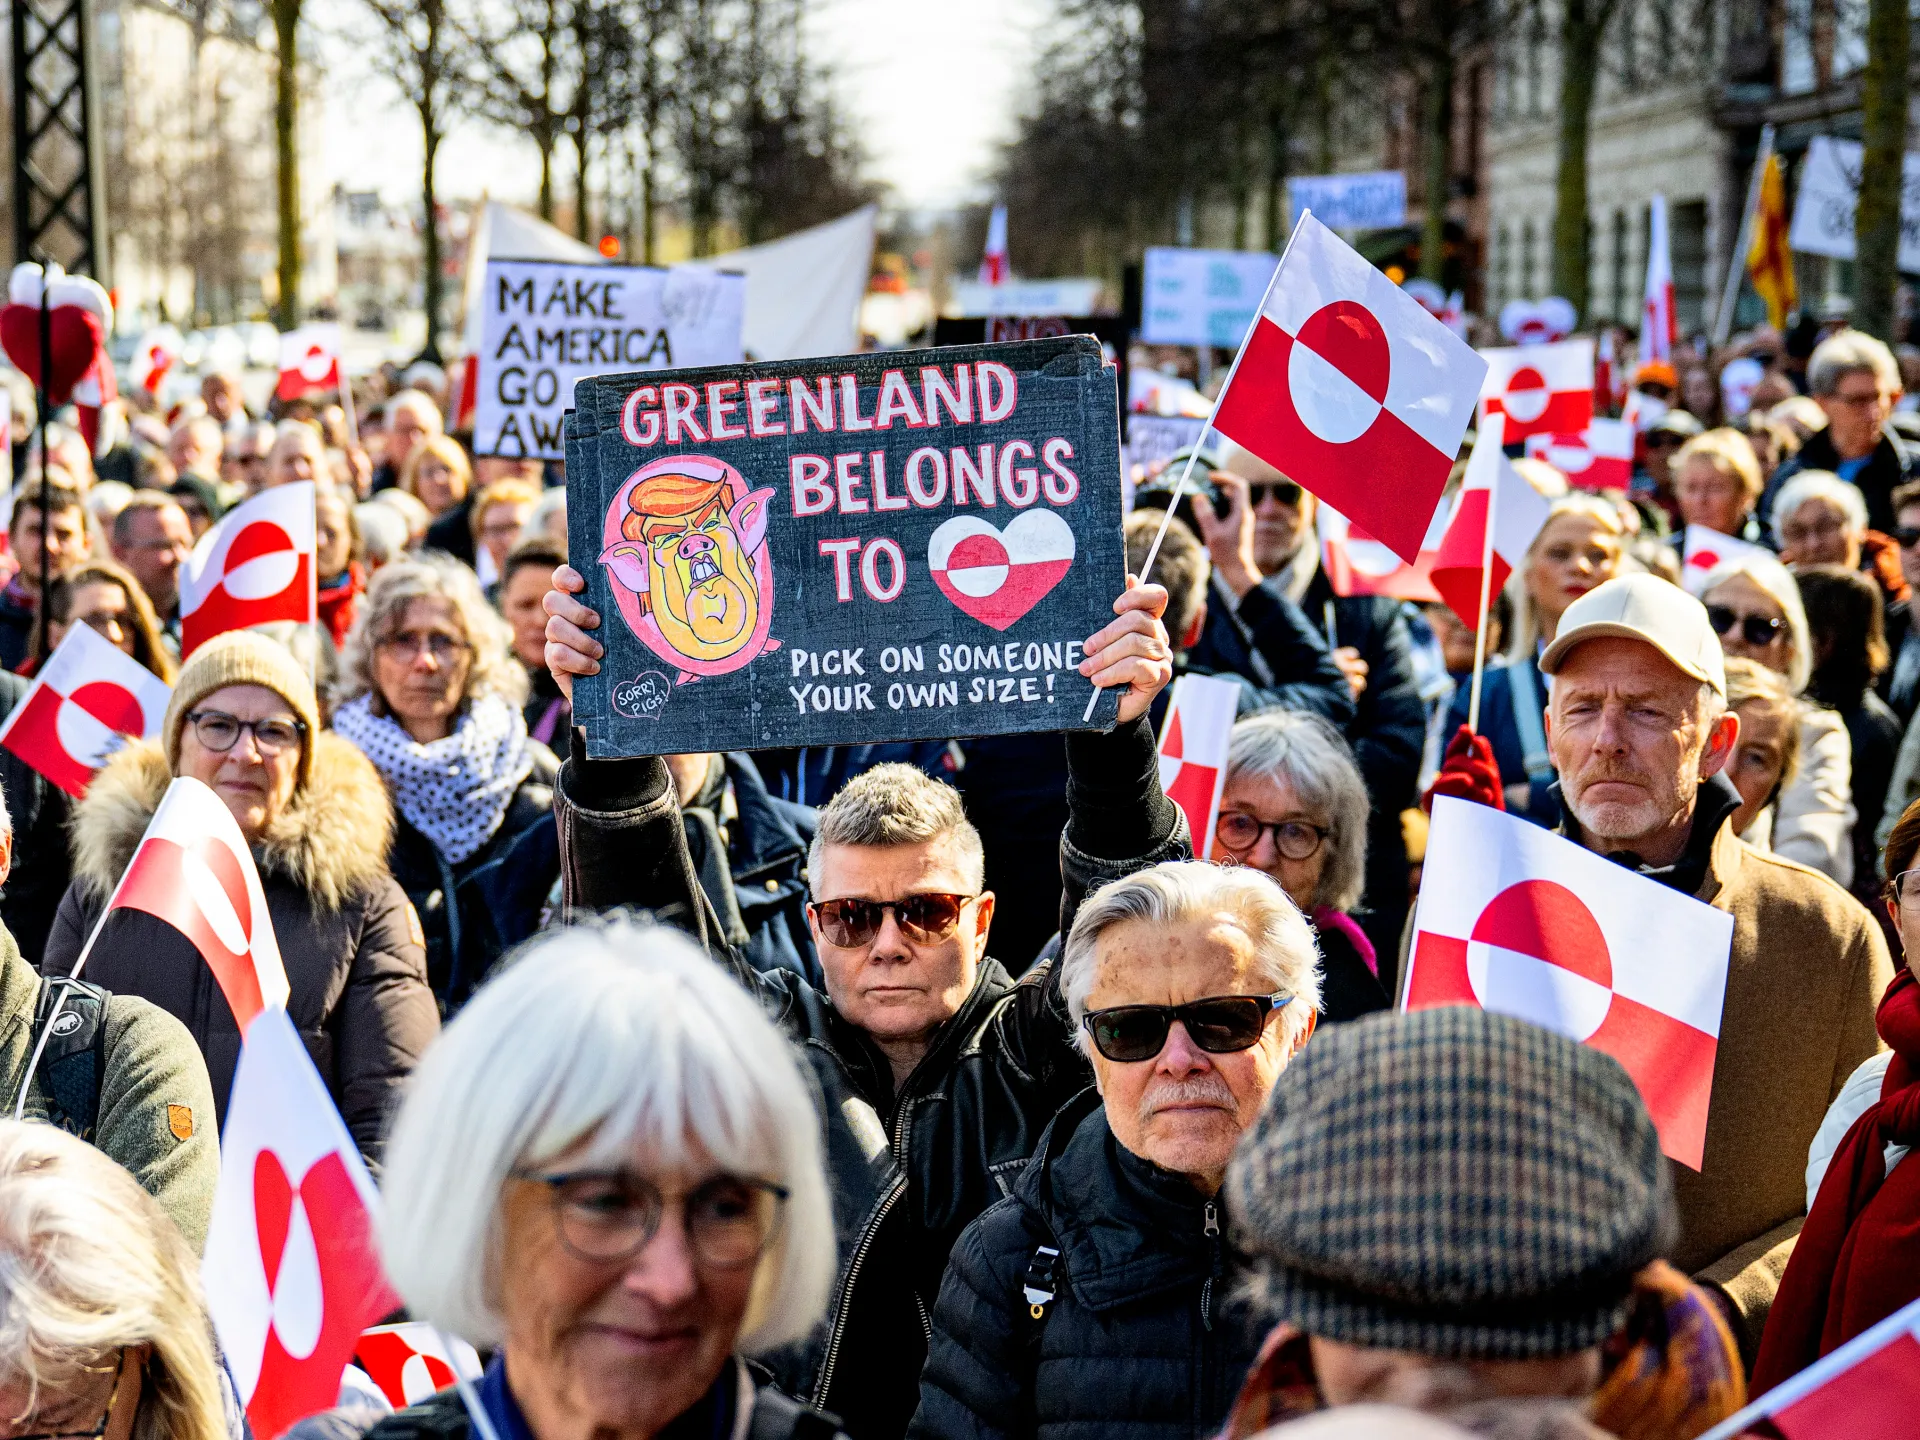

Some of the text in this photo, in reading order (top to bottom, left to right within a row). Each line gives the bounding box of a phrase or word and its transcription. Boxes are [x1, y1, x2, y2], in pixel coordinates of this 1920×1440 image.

[498, 275, 626, 320] MAKE
[495, 323, 673, 366] AMERICA
[497, 366, 558, 408] GO
[620, 361, 1018, 447] GREENLAND
[493, 412, 564, 456] AW
[789, 437, 1080, 517] BELONGS
[818, 537, 906, 603] TO
[791, 640, 1085, 677] PICK ON SOMEONE
[617, 678, 655, 706] SORRY
[631, 689, 669, 717] PIGS!
[789, 674, 1056, 714] YOUR OWN SIZE!
